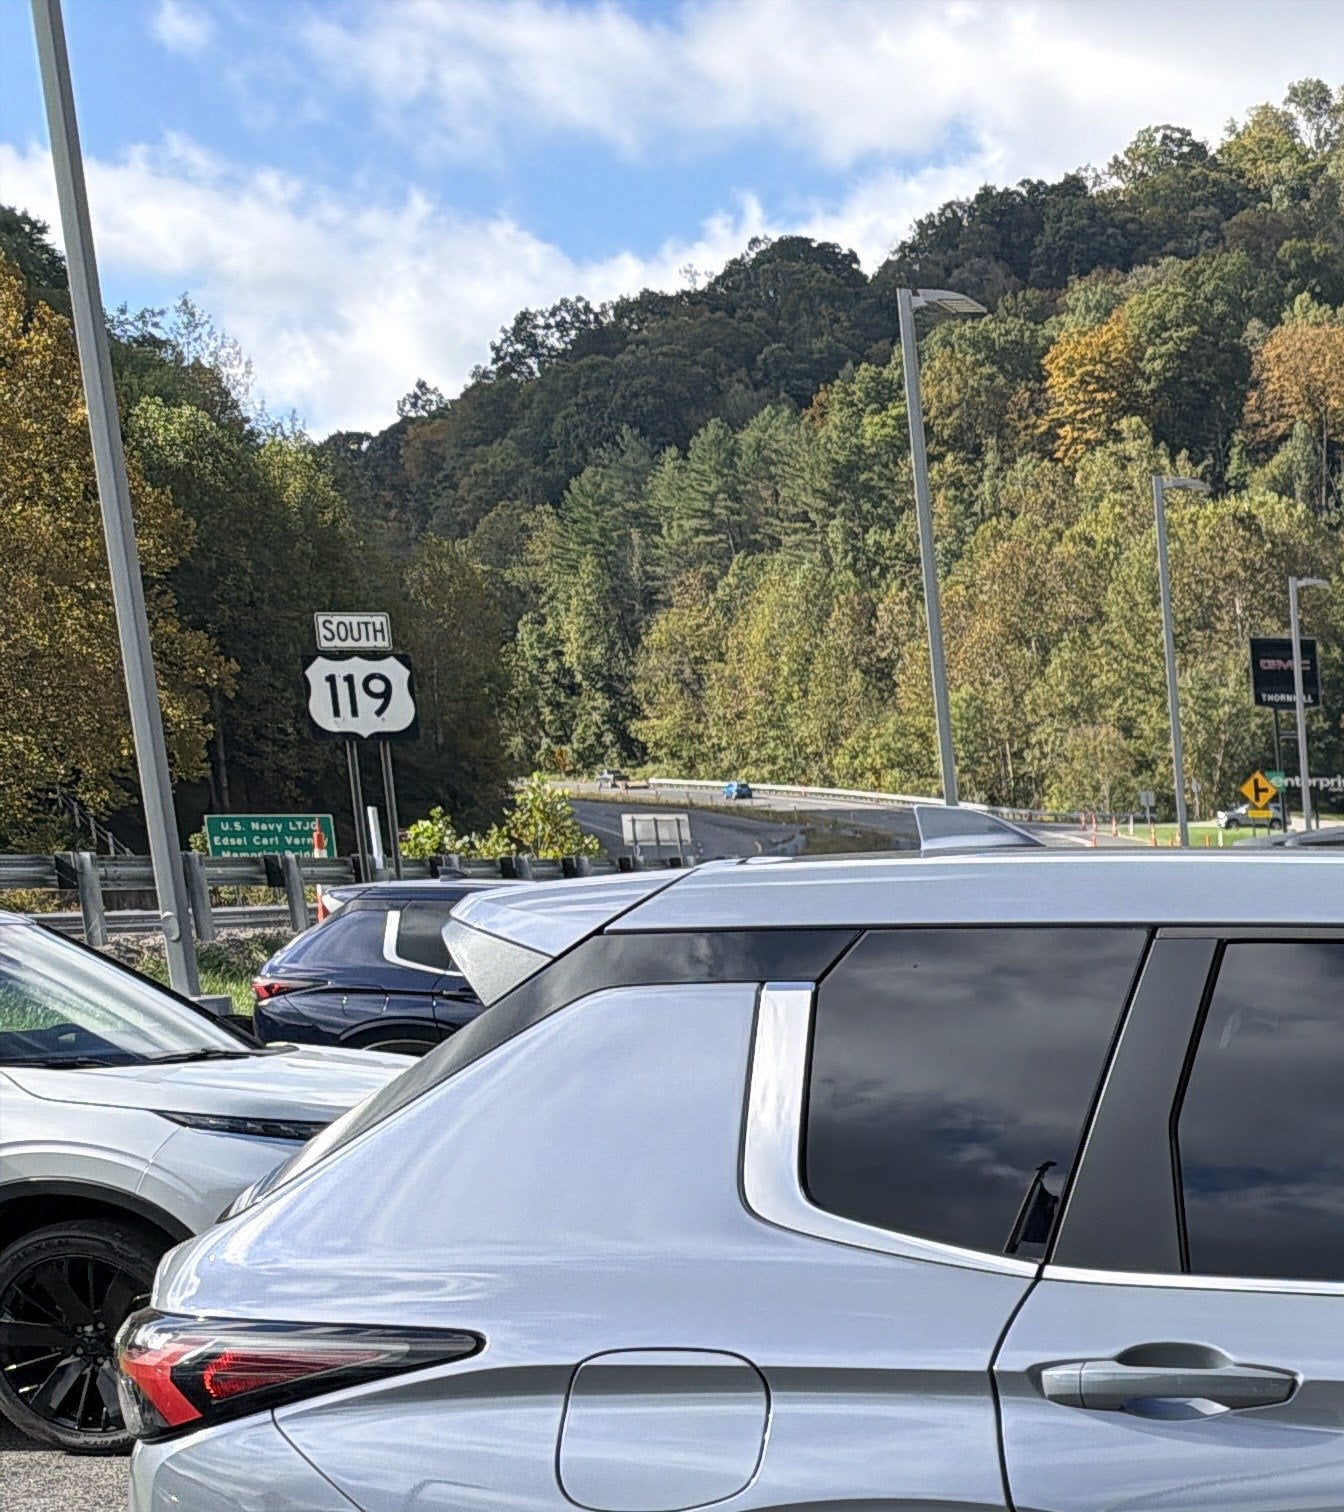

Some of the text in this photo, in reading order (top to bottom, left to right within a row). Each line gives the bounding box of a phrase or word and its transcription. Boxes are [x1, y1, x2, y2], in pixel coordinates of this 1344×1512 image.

[322, 619, 386, 643] SOUTH
[325, 673, 393, 718] 119
[220, 821, 246, 832] U.S.
[251, 821, 284, 833] Navy
[213, 835, 248, 846] Edsel
[252, 835, 279, 845] Carl
